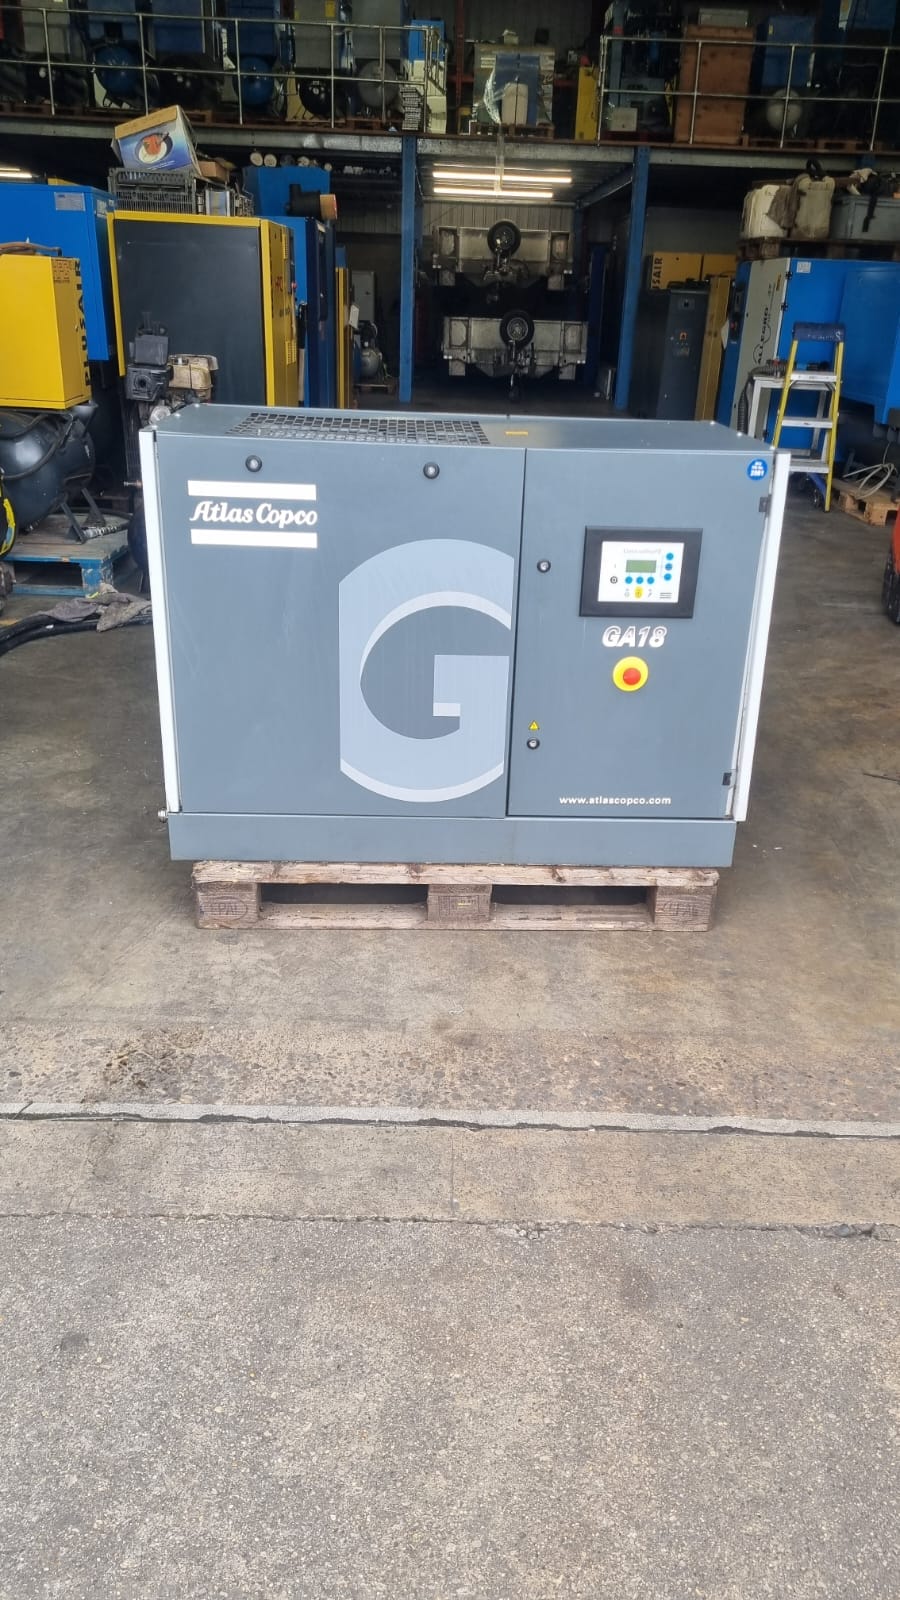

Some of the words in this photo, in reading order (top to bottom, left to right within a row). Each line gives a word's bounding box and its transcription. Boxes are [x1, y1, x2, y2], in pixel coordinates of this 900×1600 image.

[756, 307, 769, 365] ALLEGRO
[189, 501, 254, 524] Atlas
[256, 505, 318, 528] Copco
[602, 625, 667, 648] GA18
[339, 538, 515, 803] G
[559, 796, 671, 806] www.atlascopco.com
